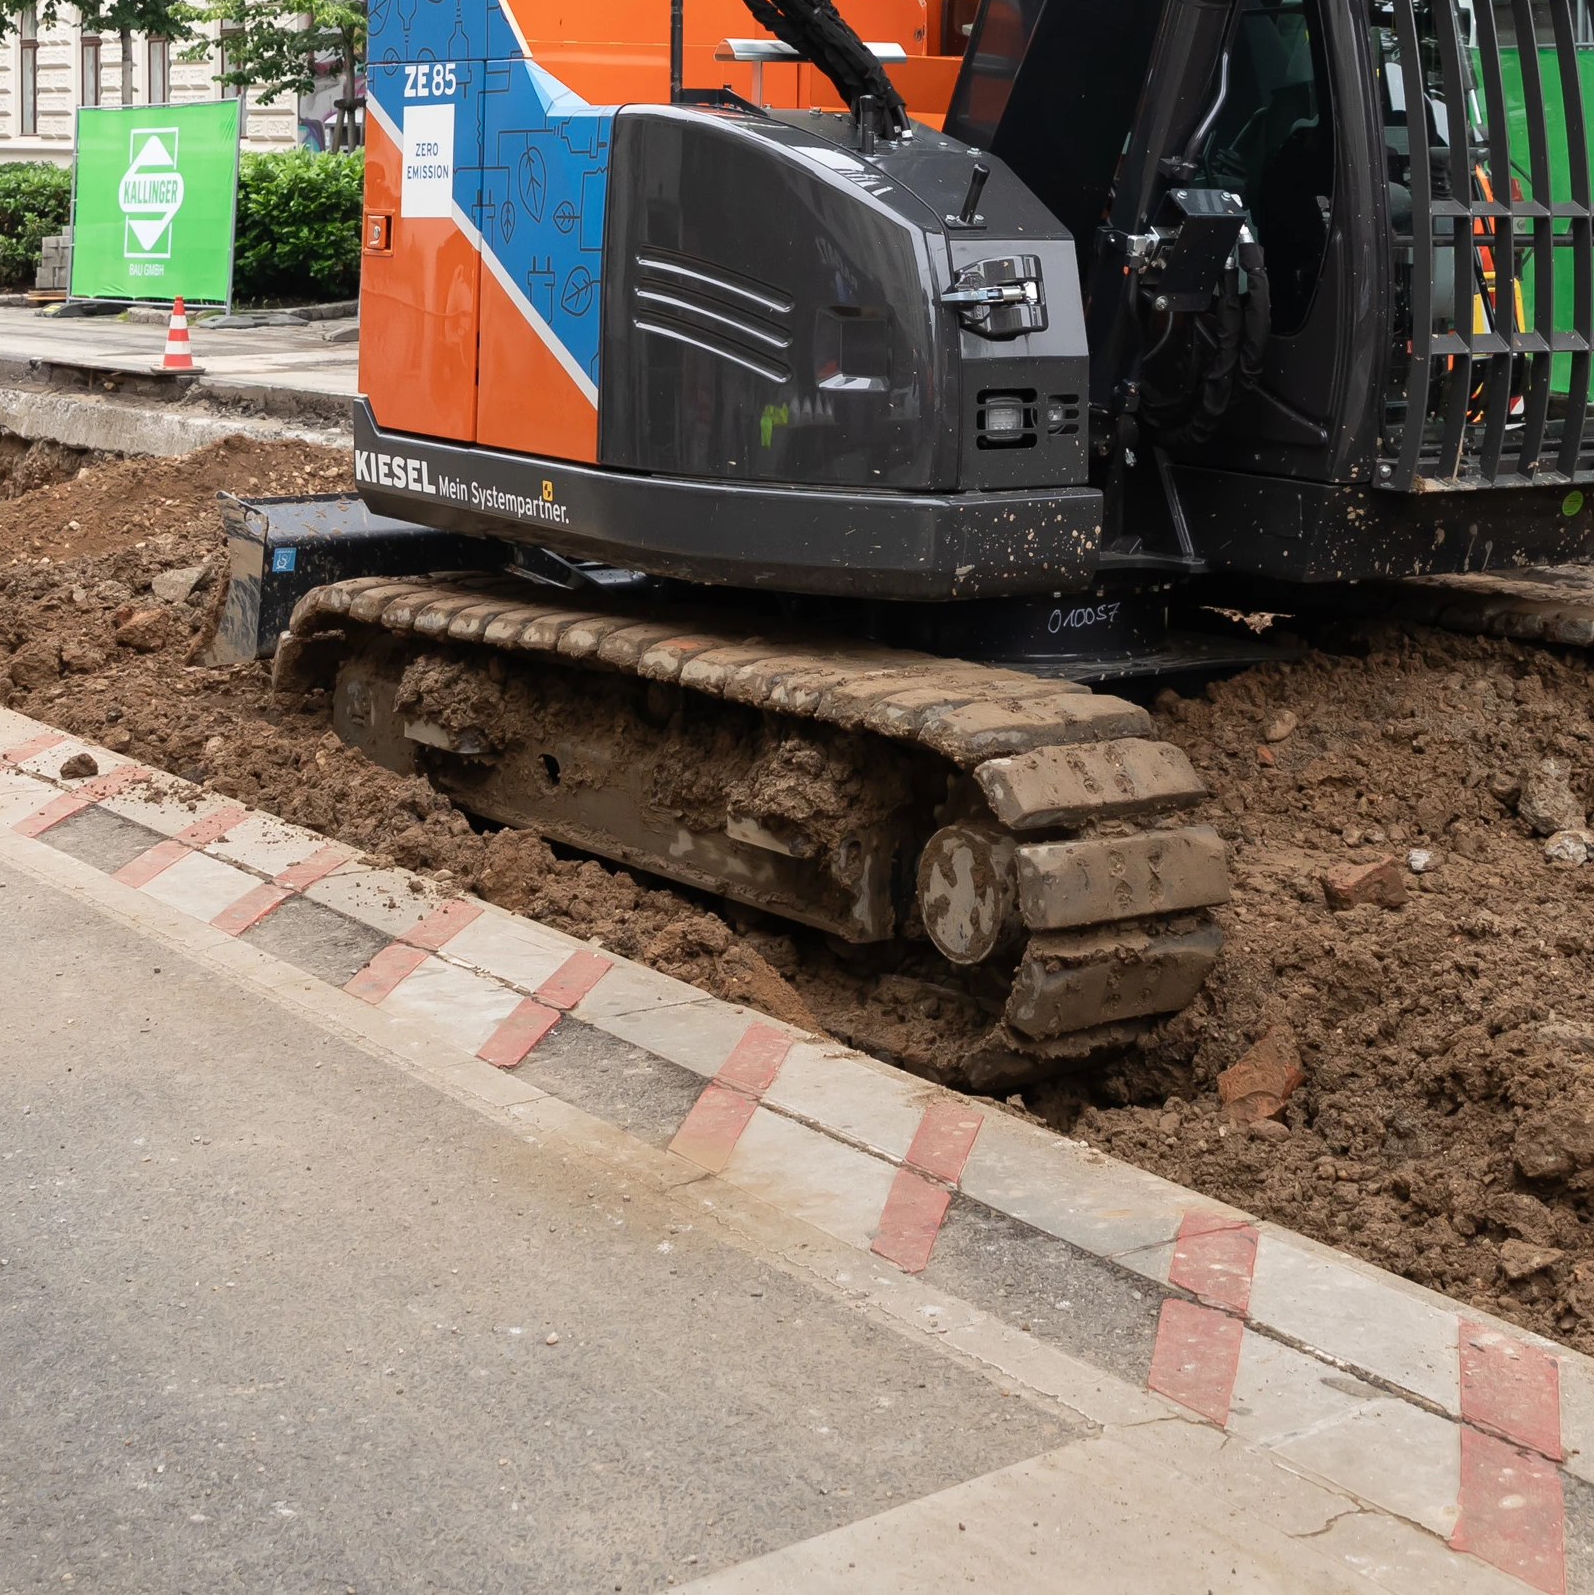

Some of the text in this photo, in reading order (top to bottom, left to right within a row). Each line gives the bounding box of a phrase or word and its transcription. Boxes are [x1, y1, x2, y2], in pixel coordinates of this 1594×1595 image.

[415, 142, 439, 157] ZERO
[406, 164, 449, 180] EMISSION
[123, 179, 178, 204] KALLINGER
[129, 263, 165, 276] BAU GMBH
[355, 449, 570, 525] KIESEL Mein Systempartner.
